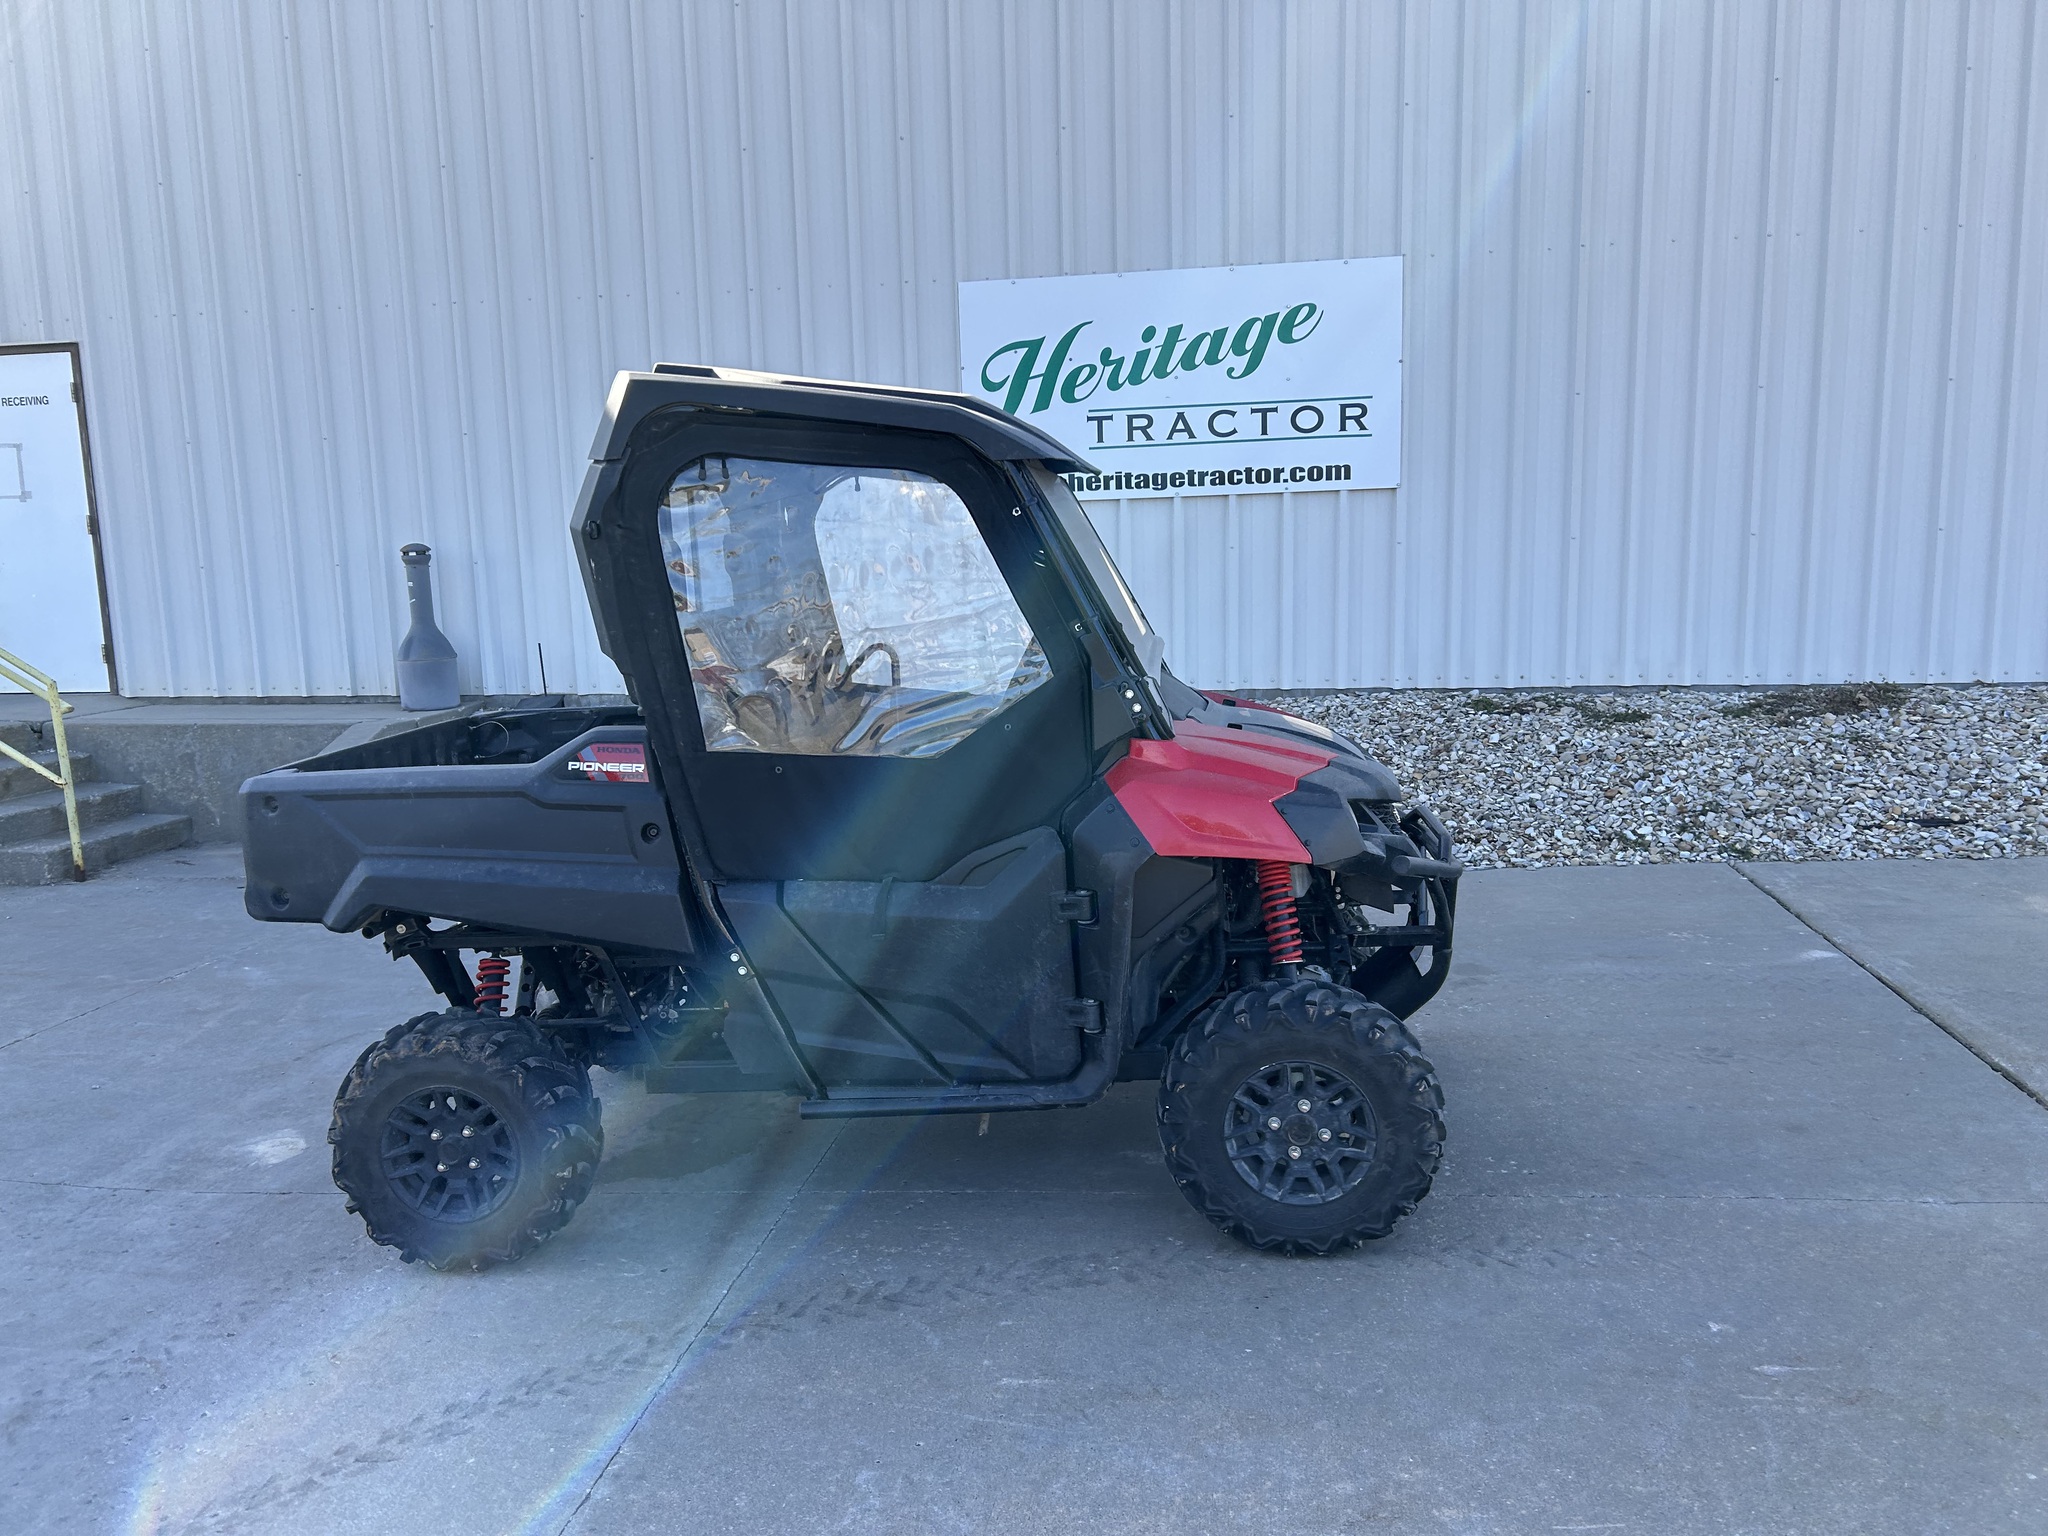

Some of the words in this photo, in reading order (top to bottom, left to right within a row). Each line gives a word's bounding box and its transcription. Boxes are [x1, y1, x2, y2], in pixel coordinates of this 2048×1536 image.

[981, 302, 1324, 416] Heritage
[1, 396, 49, 407] RECEIVING
[1086, 402, 1369, 444] TRACTOR
[1068, 463, 1352, 493] heritagetractor.com
[597, 746, 641, 754] HONDA
[567, 761, 645, 773] PIONEER
